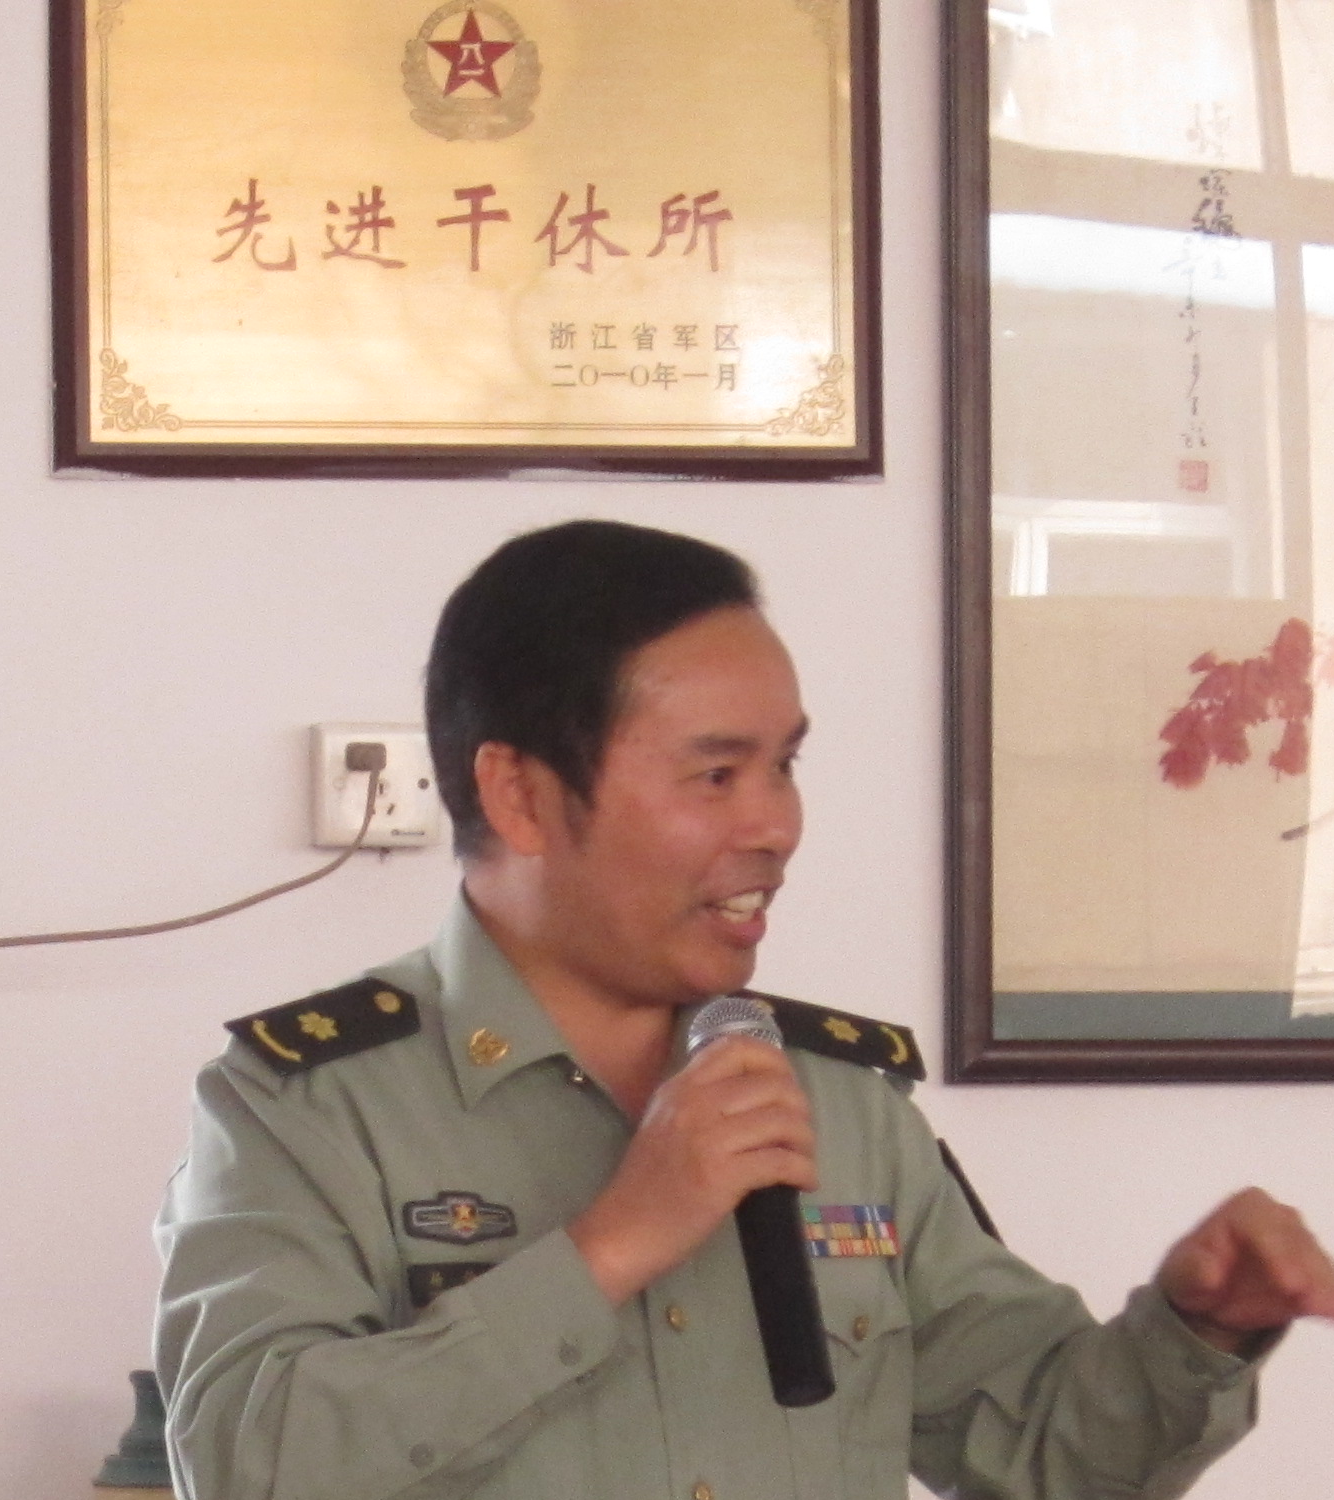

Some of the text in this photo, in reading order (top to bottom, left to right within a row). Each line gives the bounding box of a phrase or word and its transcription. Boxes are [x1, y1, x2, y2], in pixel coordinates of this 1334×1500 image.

[211, 177, 734, 274] 先进干休所
[549, 321, 741, 352] 浙江省军区
